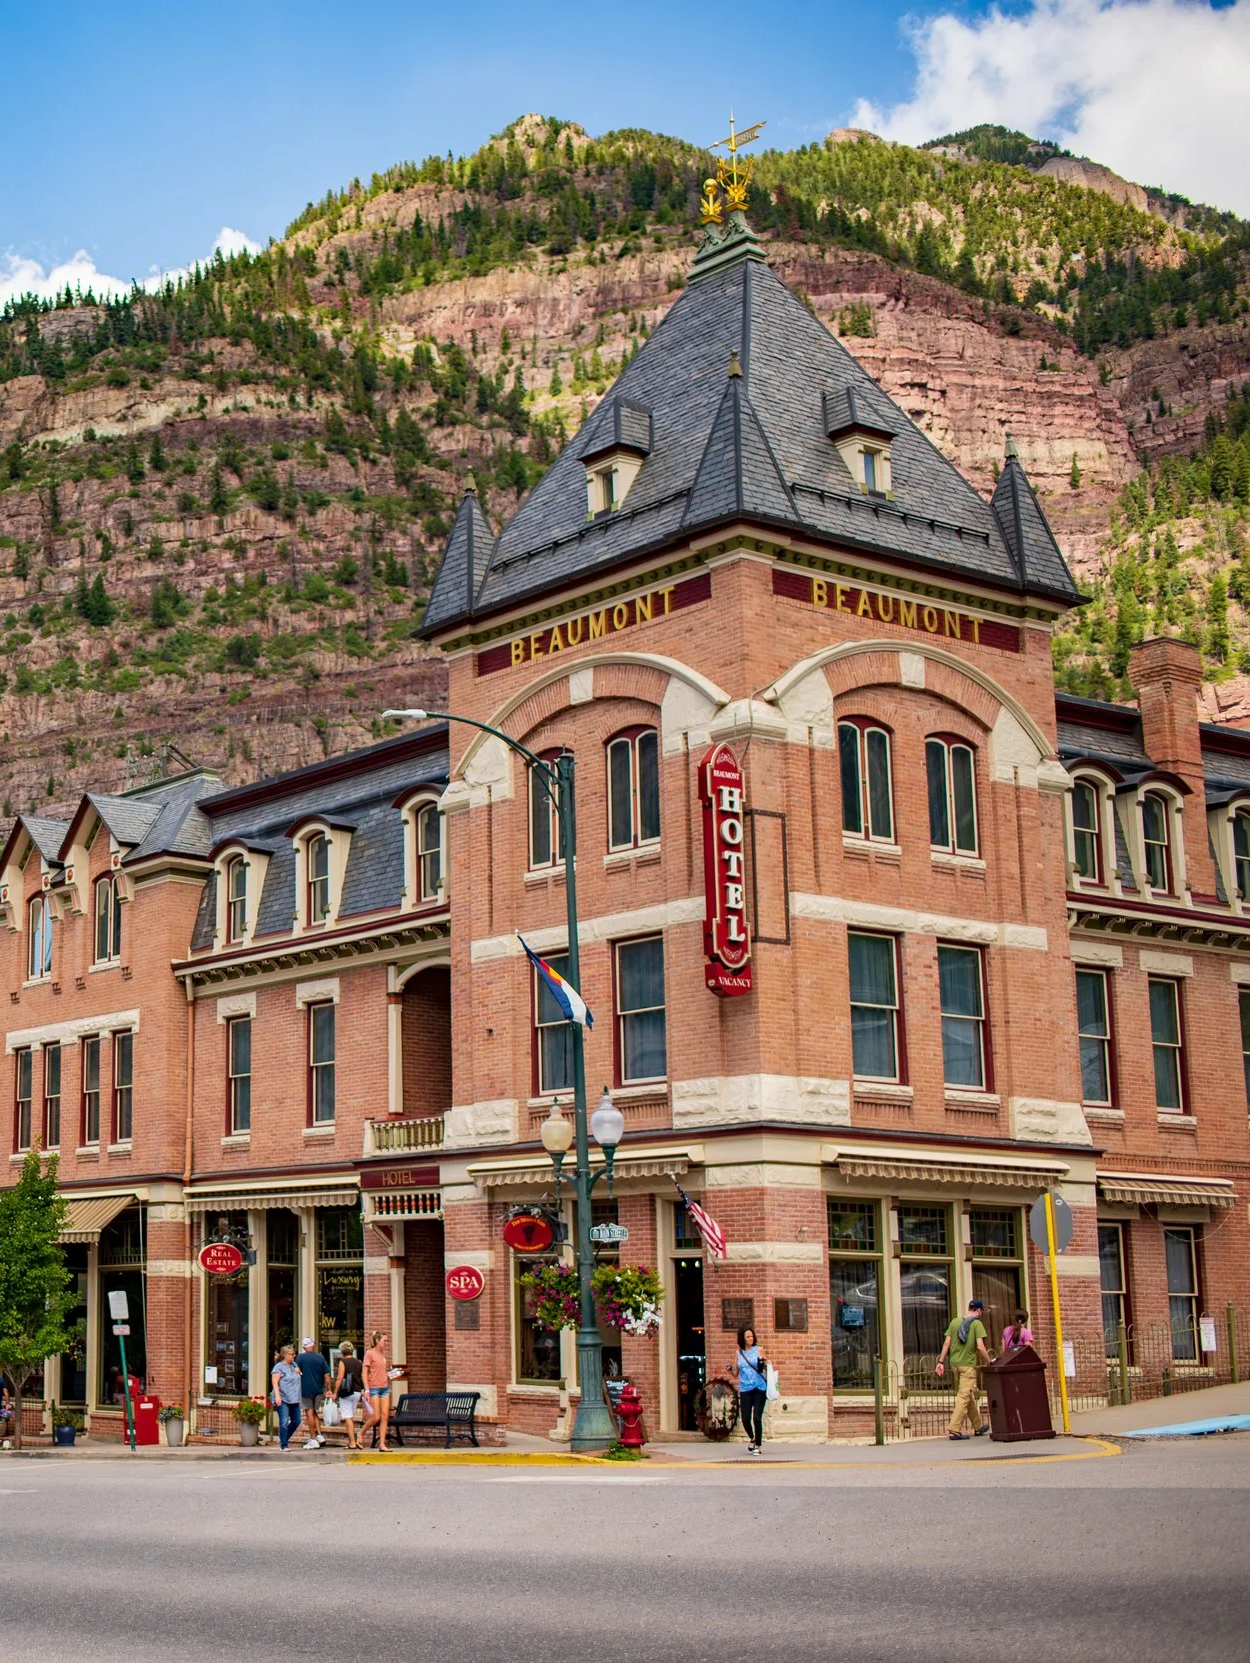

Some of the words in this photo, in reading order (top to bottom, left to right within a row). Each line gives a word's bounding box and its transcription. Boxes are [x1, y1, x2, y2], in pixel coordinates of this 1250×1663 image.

[812, 577, 984, 643] BEAUMONT
[511, 585, 675, 666] BEAUMONT
[713, 769, 740, 781] BEAUMONT
[717, 785, 746, 942] HOTEL
[718, 976, 751, 988] VACANCY
[382, 1170, 415, 1186] HOTEL
[323, 1270, 362, 1291] Luxury
[450, 1276, 479, 1289] SPA
